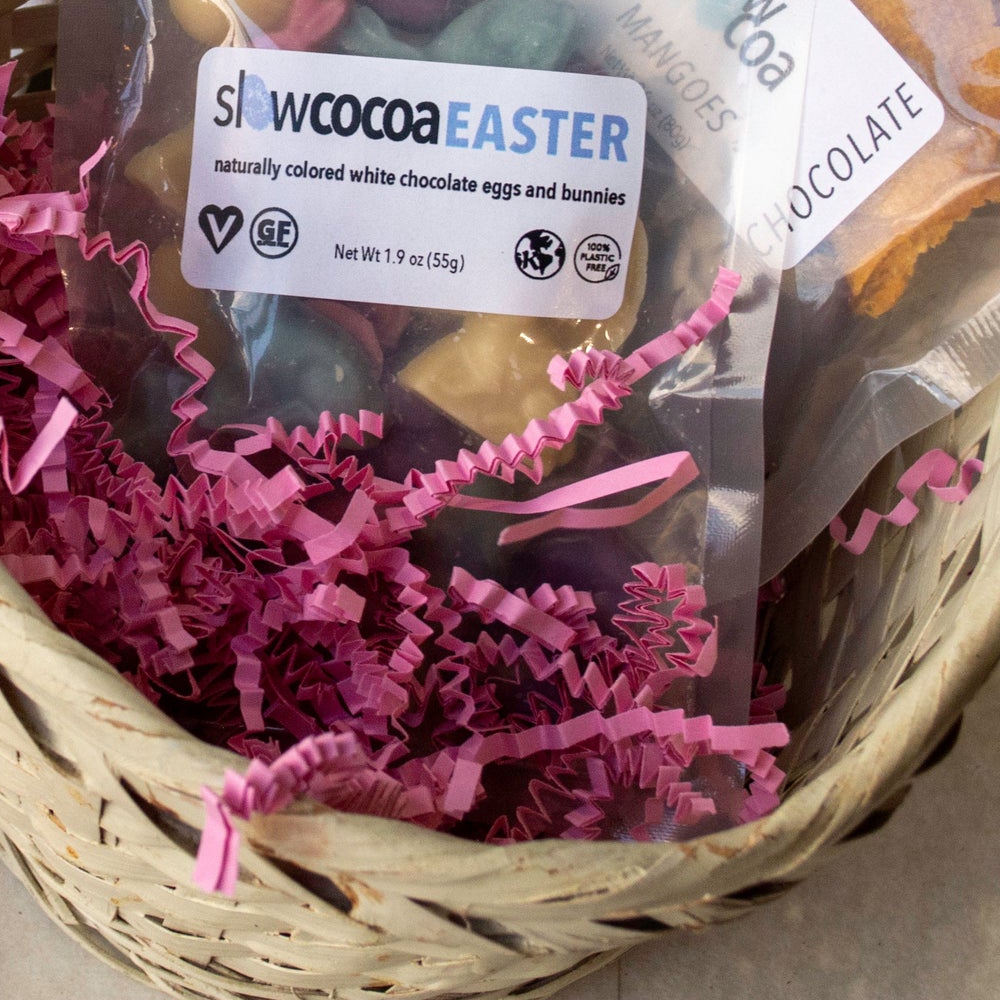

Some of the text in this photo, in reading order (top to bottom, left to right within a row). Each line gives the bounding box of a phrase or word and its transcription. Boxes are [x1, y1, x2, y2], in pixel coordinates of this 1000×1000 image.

[616, 1, 738, 133] MANGOES
[214, 157, 626, 207] naturally colored white chocolate eggs and bunnies
[748, 82, 923, 260] CHOCOLATE
[334, 244, 465, 273] Net Wt 1.9 oz (55g)
[581, 253, 615, 262] PLASTIC
[587, 243, 610, 252] 100%
[586, 263, 606, 272] FREE
